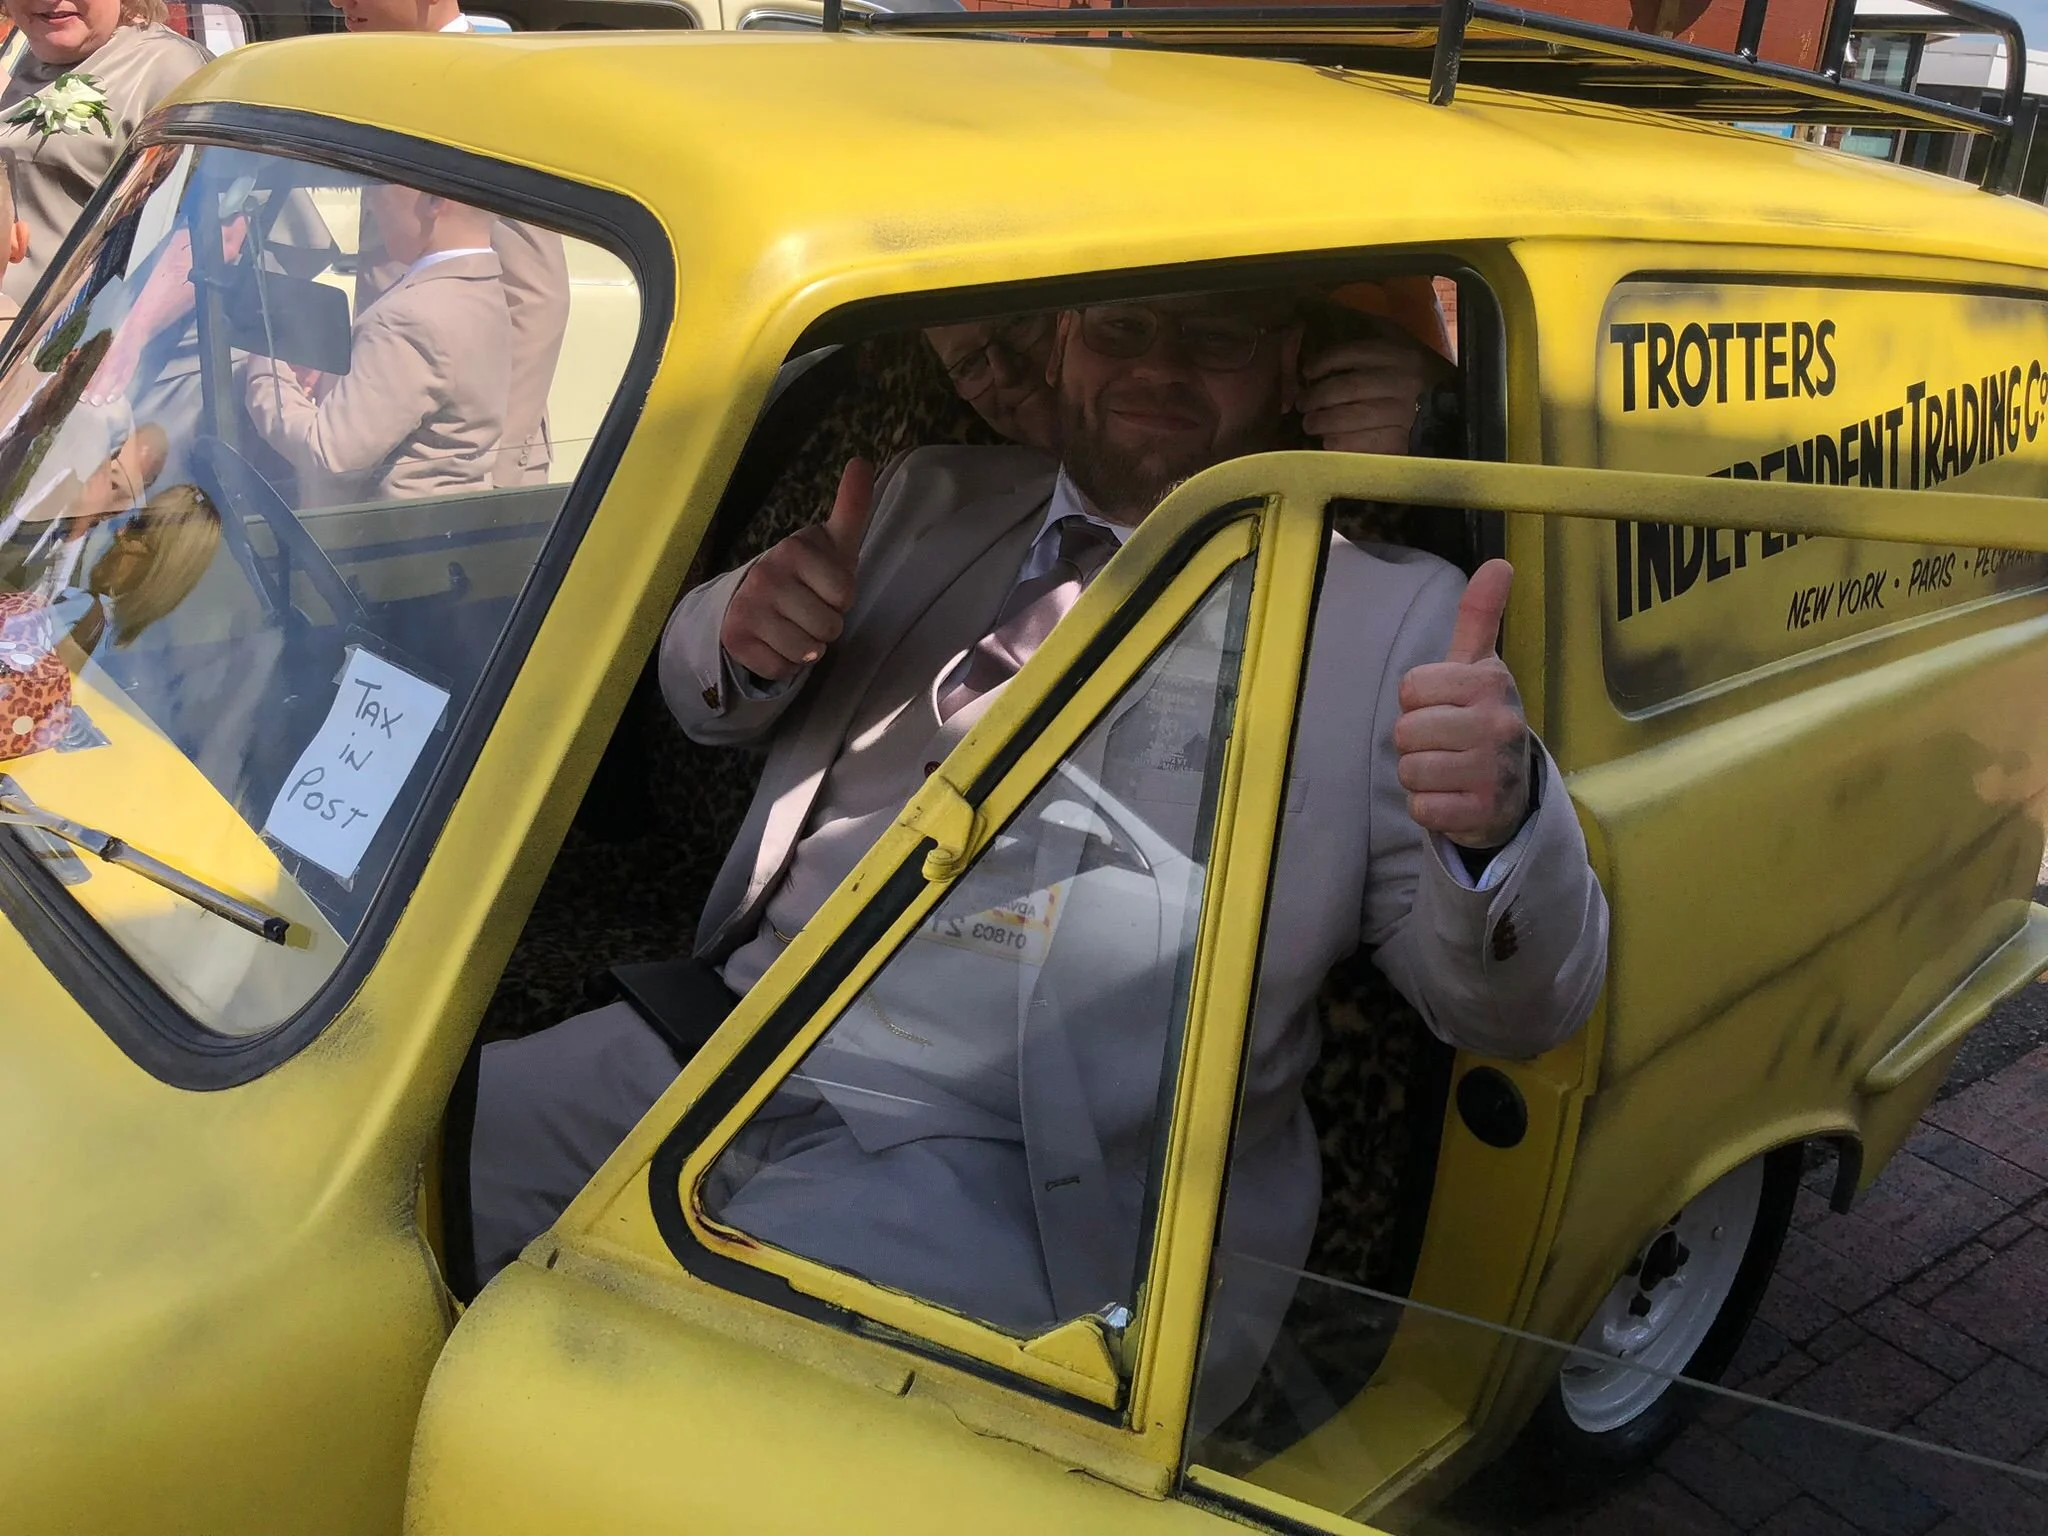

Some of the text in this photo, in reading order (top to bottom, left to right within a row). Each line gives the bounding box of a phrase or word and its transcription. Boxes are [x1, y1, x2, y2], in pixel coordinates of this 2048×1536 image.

[1609, 319, 1837, 412] TROTTERS
[1906, 365, 2022, 491] TRADING
[1787, 582, 1834, 632] NEW
[1836, 569, 1887, 618] YORK
[1908, 552, 1956, 596] PARIS
[355, 678, 404, 739] TAX
[287, 766, 368, 829] POST
